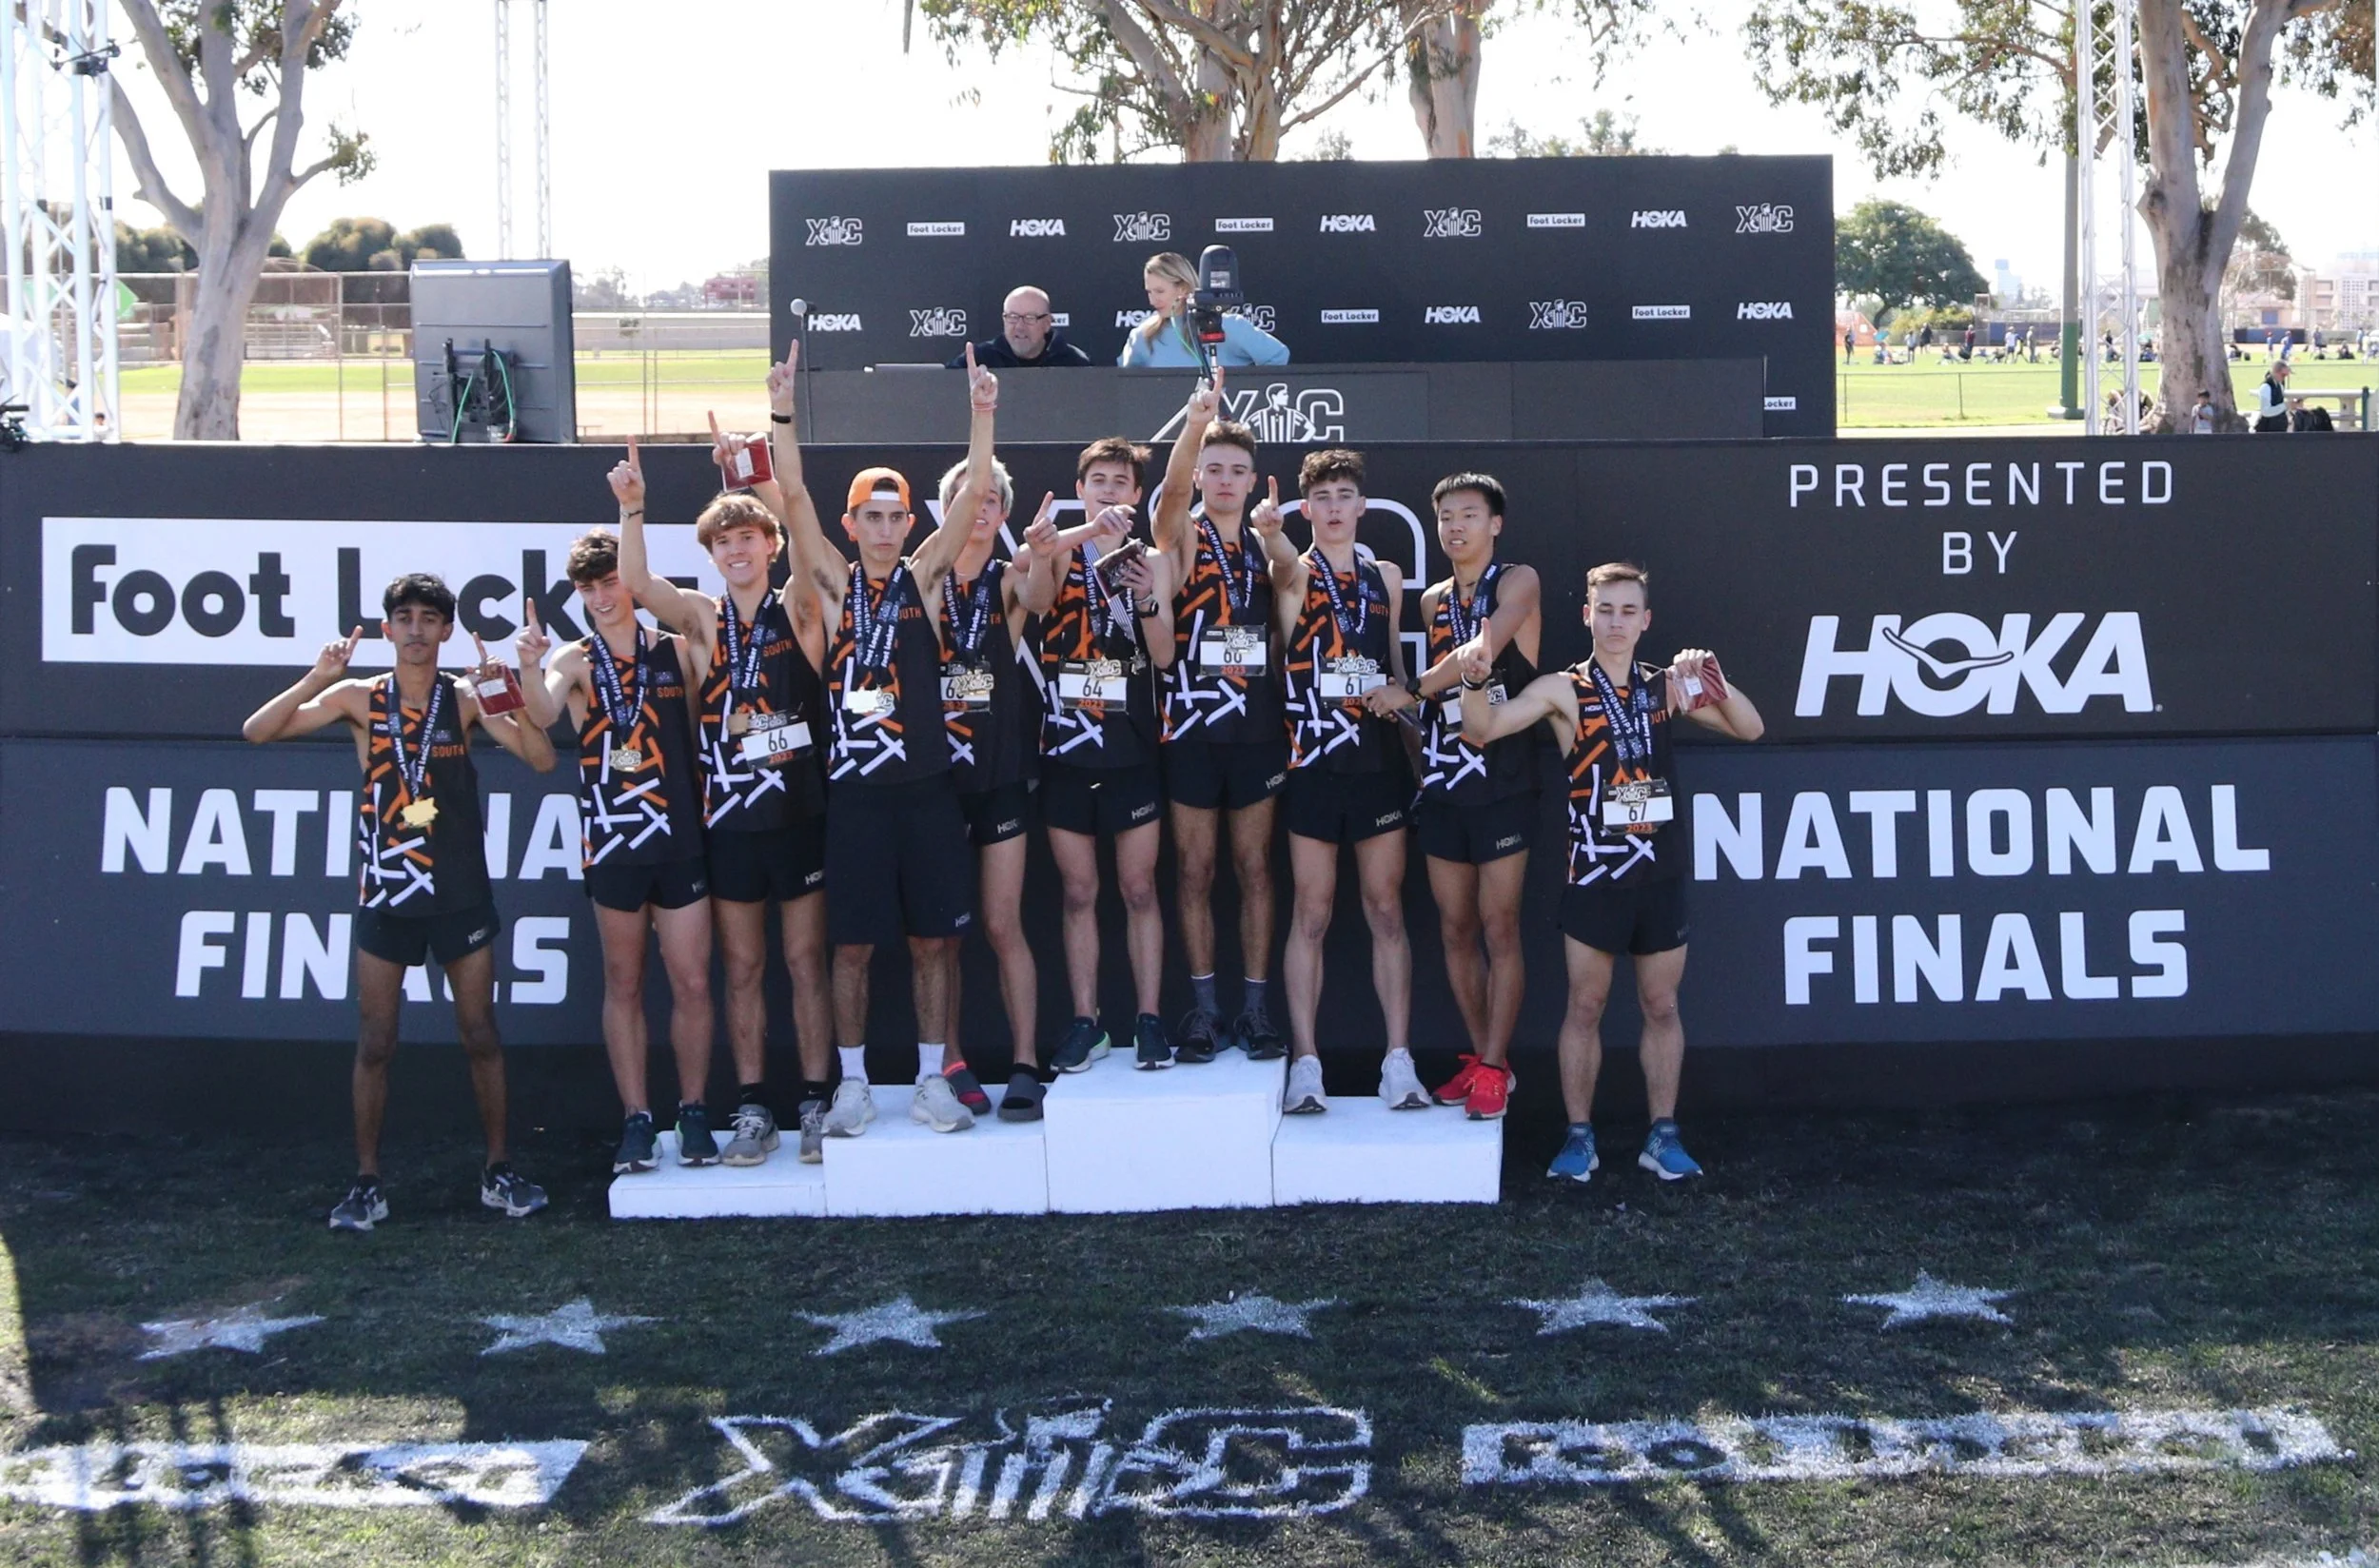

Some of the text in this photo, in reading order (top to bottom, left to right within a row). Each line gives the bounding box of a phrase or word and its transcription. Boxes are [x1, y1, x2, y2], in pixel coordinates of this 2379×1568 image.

[1218, 221, 1270, 229] Foot Locker
[1320, 215, 1375, 232] HOKA
[1529, 216, 1582, 225] Foot Locker
[1631, 210, 1687, 227] HOKA
[910, 225, 961, 233] Foot Locker
[1010, 219, 1066, 236] HOKA
[1115, 310, 1154, 327] HO
[1324, 312, 1376, 321] Foot Locker
[1425, 306, 1480, 323] HOKA
[1635, 307, 1687, 317] Foot Locker
[1738, 303, 1793, 319] HOKA
[809, 314, 862, 331] HOKA
[1764, 399, 1793, 407] ocker
[1790, 461, 2173, 507] PRESENTED
[1202, 519, 1234, 584] CHAMPIONSHIPS
[1942, 531, 2017, 575] BY
[1310, 550, 1343, 610] CHAMPIONSHIPS
[338, 546, 698, 643] Lck
[854, 565, 864, 639] CHAMPIONSHIPS
[945, 574, 960, 629] MPIONSHIPS
[898, 606, 922, 620] UTH
[1369, 602, 1389, 617] OUT
[762, 638, 793, 657] SOUTH
[594, 633, 623, 702] CHAMPIONSHIPS
[1795, 612, 2154, 717] HOKA
[1082, 677, 1103, 698] 64
[1345, 676, 1363, 696] 61
[1342, 697, 1363, 707] 202
[1592, 667, 1634, 735] CHAMPIONSHIPS
[1650, 709, 1666, 725] OUT
[768, 729, 788, 752] 66
[431, 744, 465, 758] SOUTH
[1266, 772, 1286, 789] HOK
[1375, 810, 1403, 827] HOKA
[1628, 802, 1648, 822] 67
[101, 786, 585, 881] NATIA
[996, 818, 1018, 834] HOK
[1625, 823, 1653, 833] 2023
[1692, 785, 2271, 881] NATIONAL
[804, 869, 824, 885] HO
[467, 929, 488, 945] HO
[175, 911, 570, 1005] FINS
[1783, 910, 2189, 1005] FINALS
